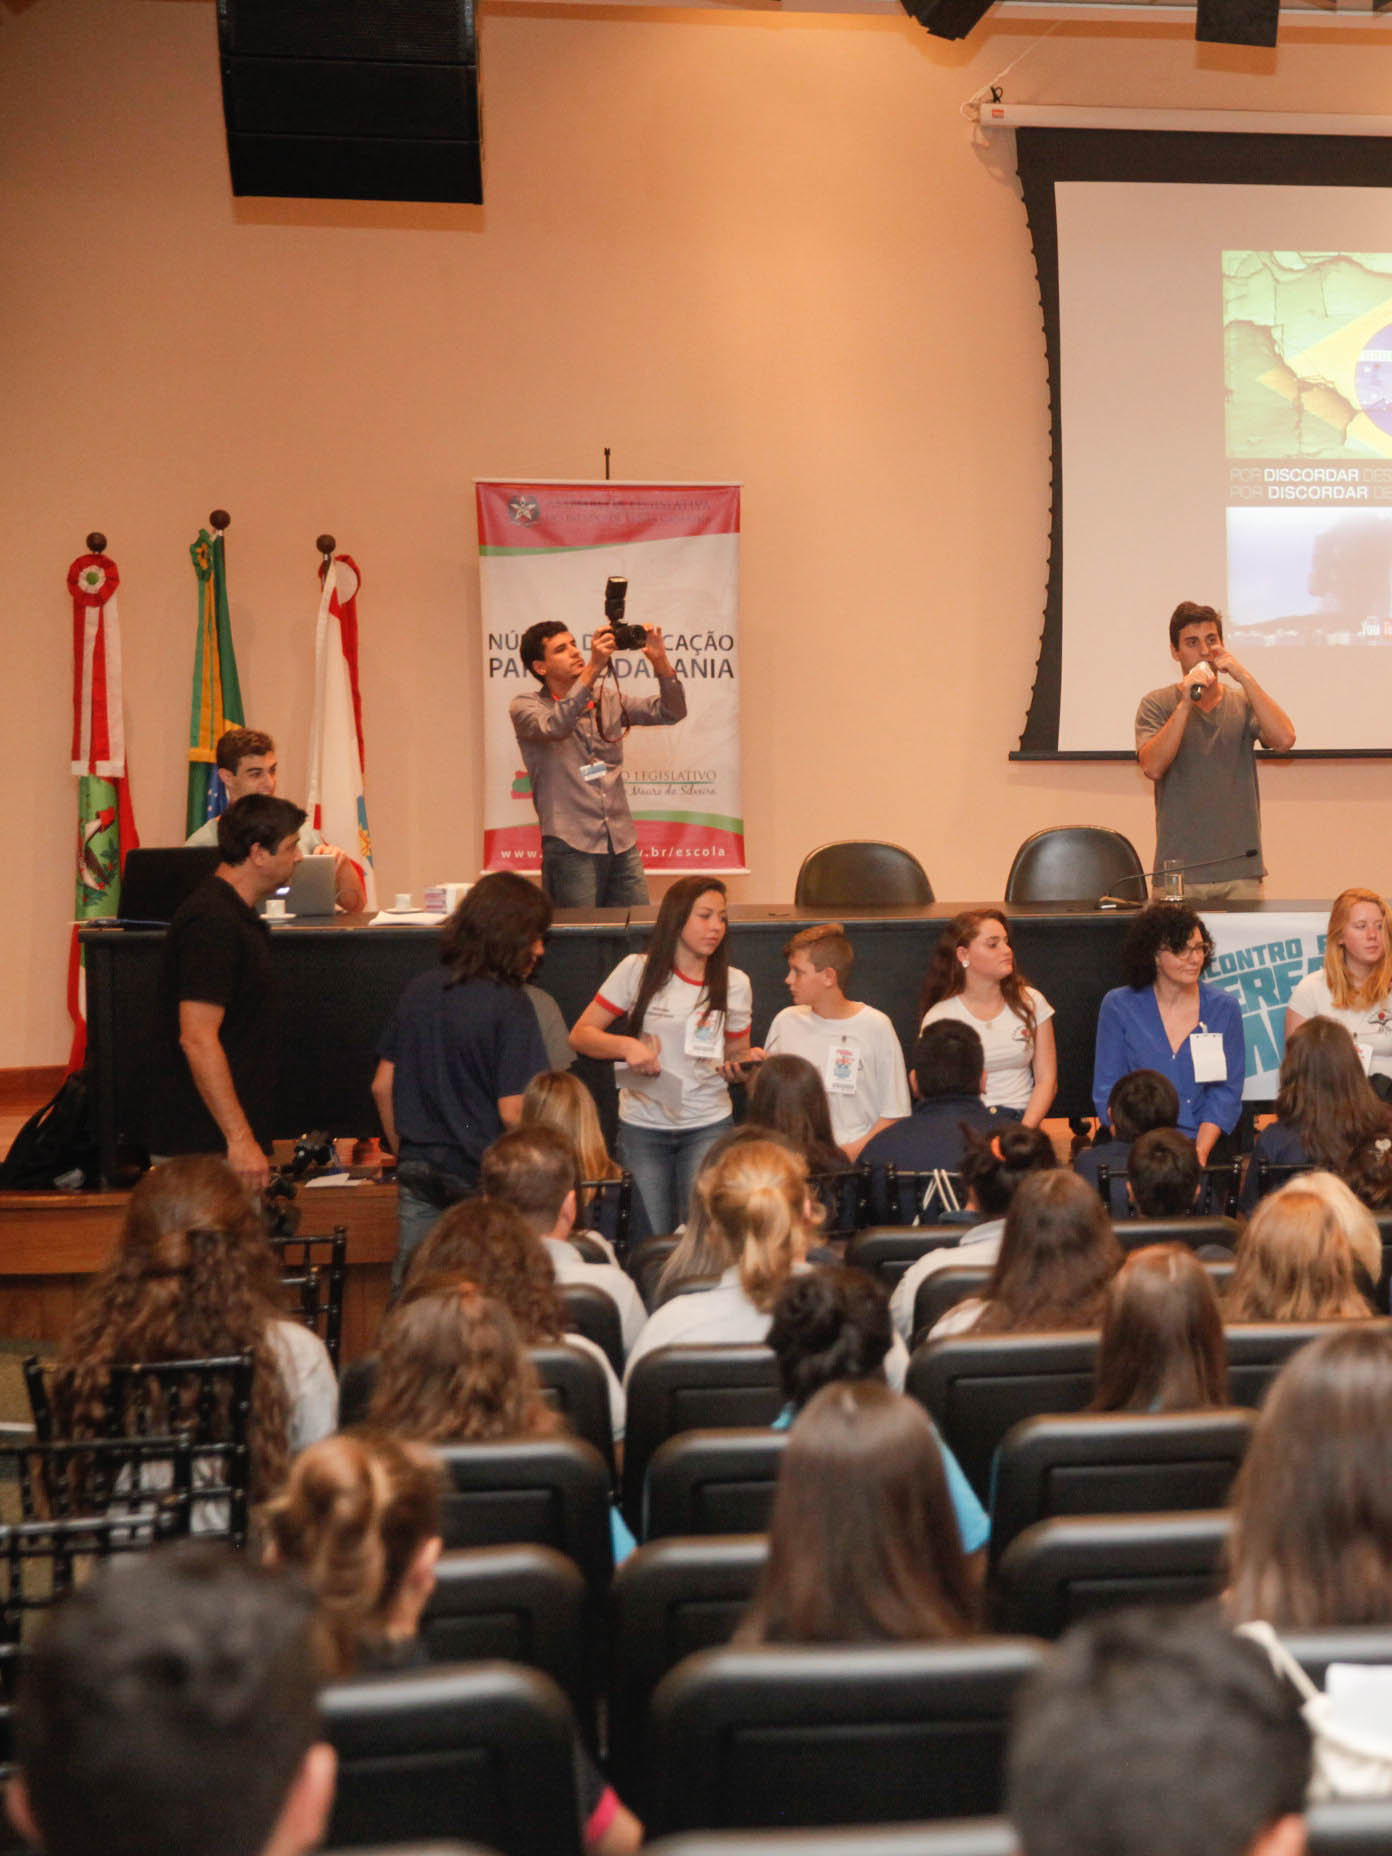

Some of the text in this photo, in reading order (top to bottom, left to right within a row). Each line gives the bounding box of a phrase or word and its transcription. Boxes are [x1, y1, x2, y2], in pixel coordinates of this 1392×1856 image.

[1264, 469, 1359, 482] DISCORDAR
[1268, 486, 1368, 499] DISCORDAR
[635, 770, 717, 781] LEGISLATIVO
[1206, 938, 1303, 978] CONTRO
